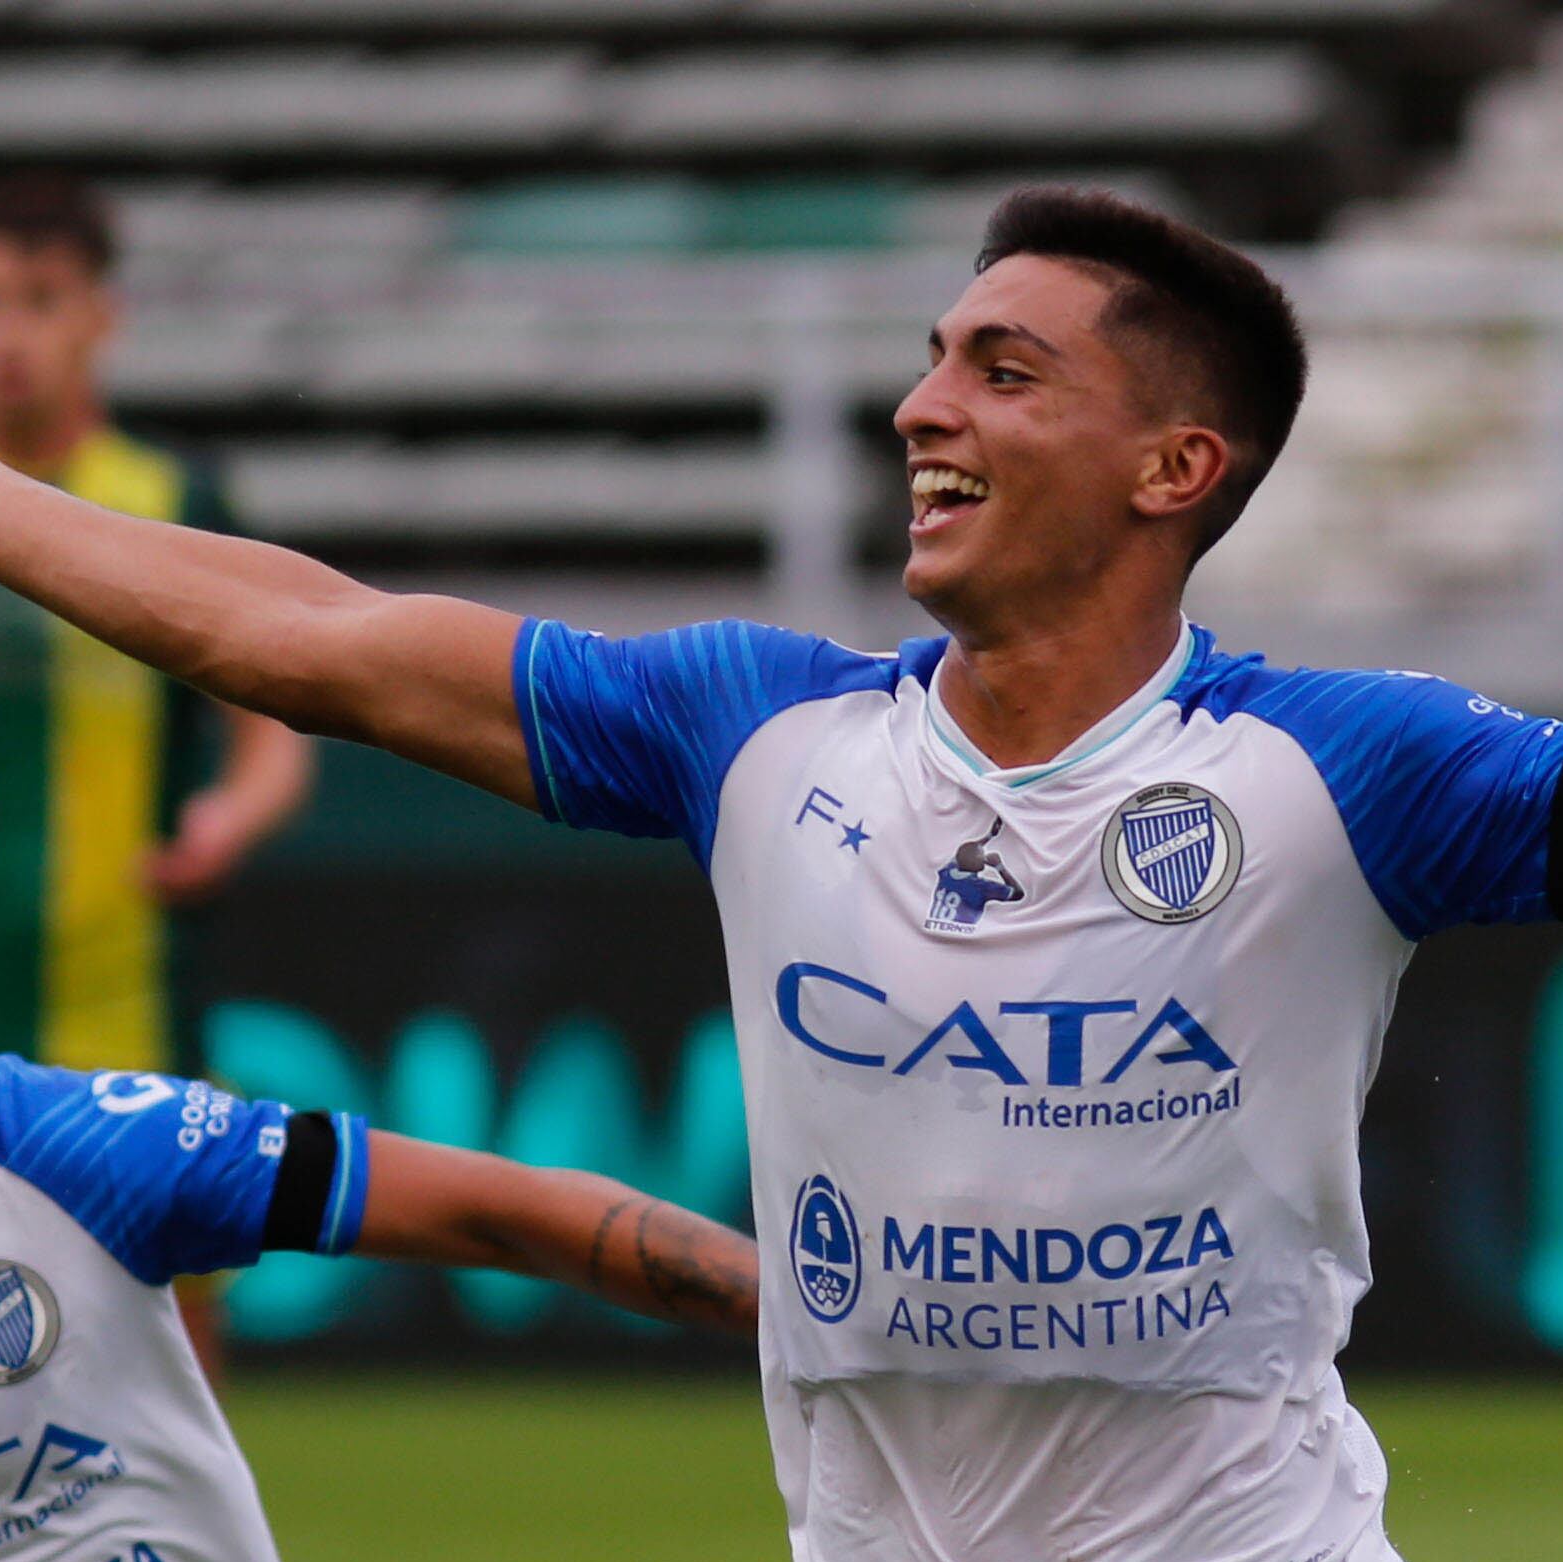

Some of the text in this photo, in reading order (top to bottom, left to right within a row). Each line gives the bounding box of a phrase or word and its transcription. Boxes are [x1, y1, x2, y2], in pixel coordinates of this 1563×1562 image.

[775, 961, 1239, 1087] CATA
[1001, 1077, 1240, 1129] Internacional
[882, 1206, 1235, 1284] MENDOZA
[886, 1280, 1231, 1351] ARGENTINA
